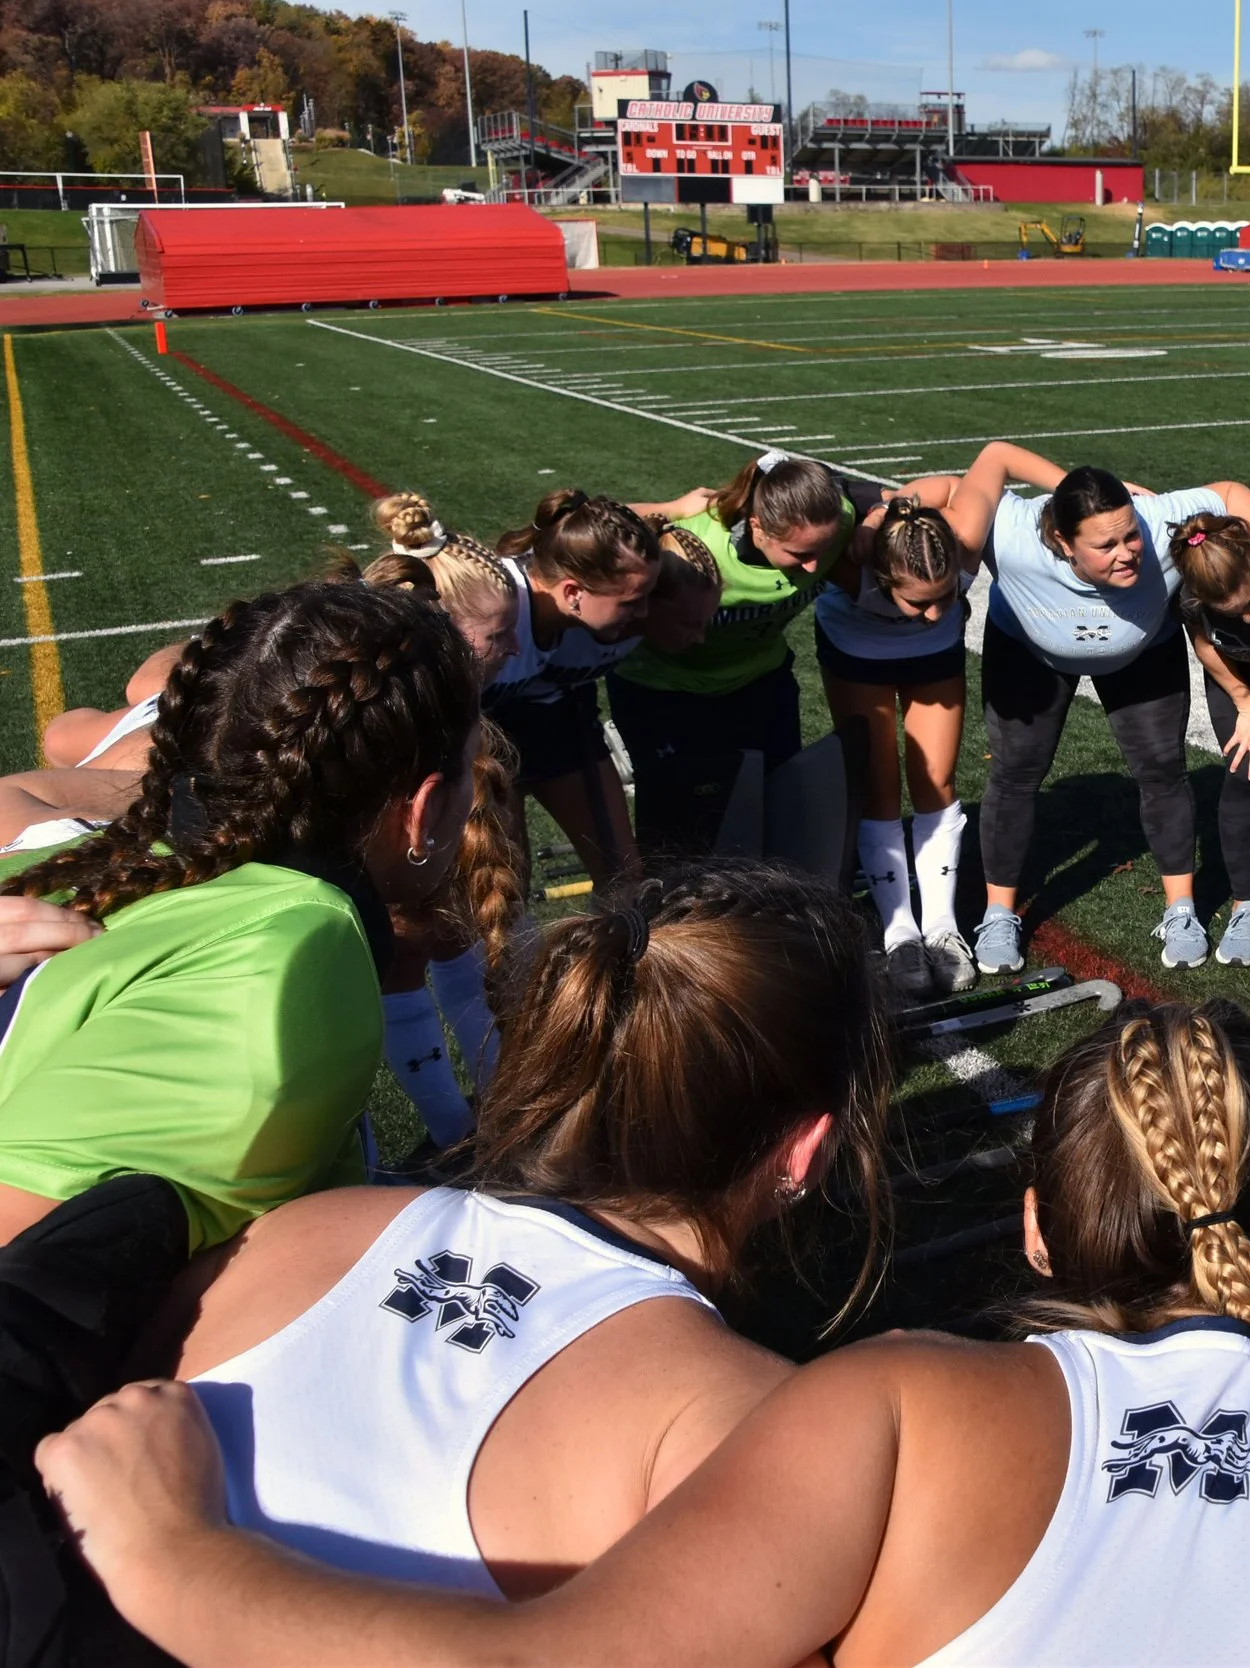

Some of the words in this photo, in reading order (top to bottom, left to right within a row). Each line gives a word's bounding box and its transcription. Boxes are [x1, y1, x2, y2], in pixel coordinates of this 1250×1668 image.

[627, 101, 694, 120] CATHOLIC
[695, 103, 774, 123] UNIVERSITY
[751, 124, 781, 136] GUEST
[645, 149, 668, 159] DOWN
